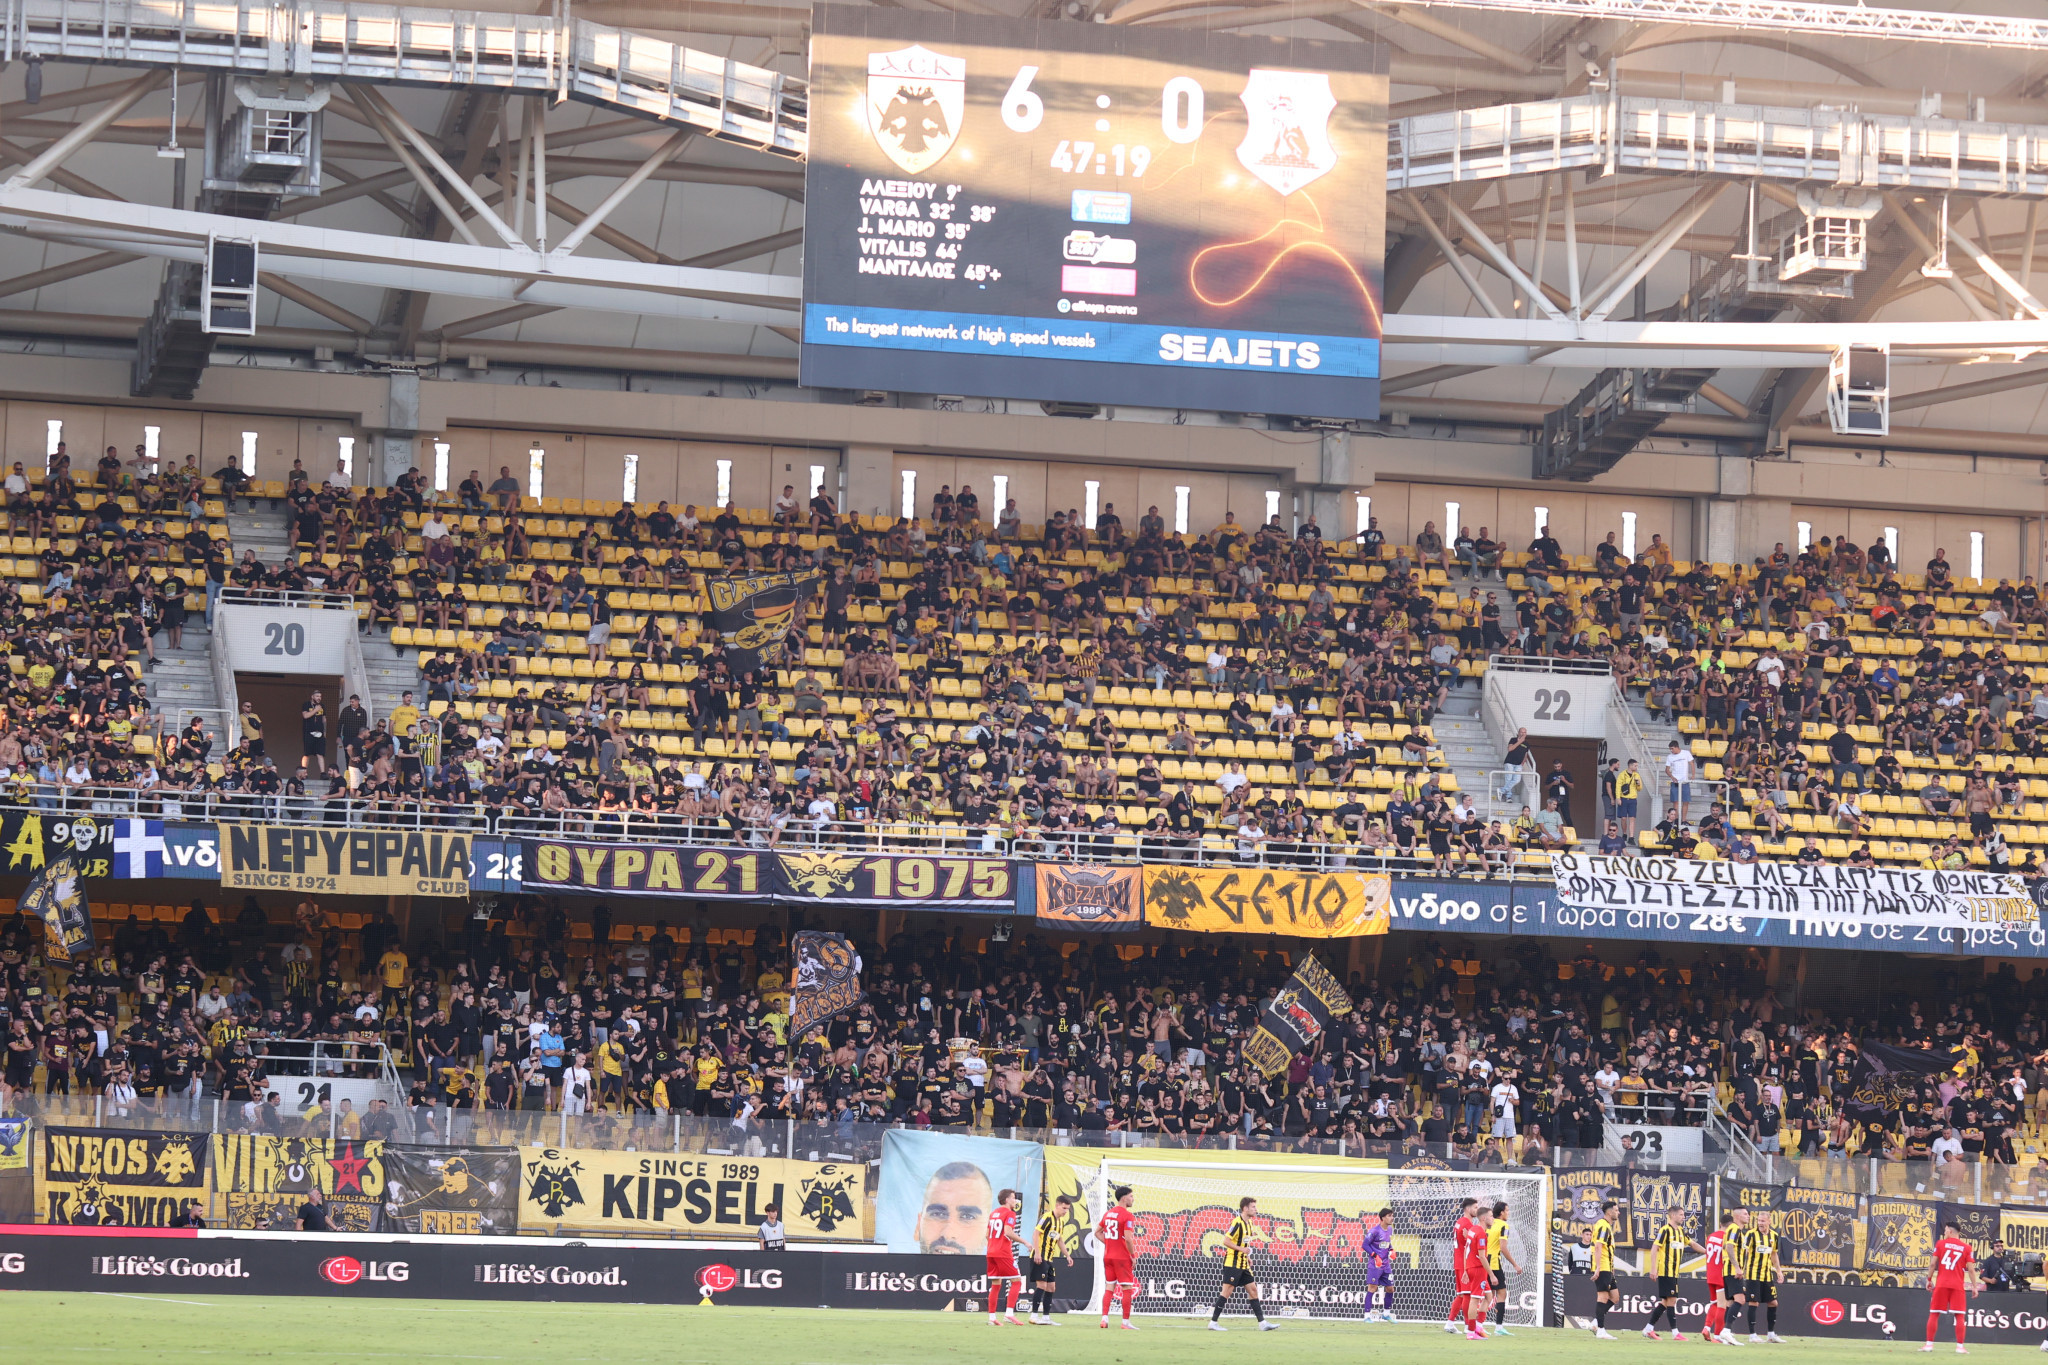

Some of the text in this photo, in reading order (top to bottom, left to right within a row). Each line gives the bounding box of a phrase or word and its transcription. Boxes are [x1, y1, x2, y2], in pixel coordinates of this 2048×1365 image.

[1001, 66, 1043, 133] 6
[1162, 76, 1204, 143] 0
[1050, 140, 1151, 178] 47:19
[860, 179, 937, 199] ΑΛΕΞΙΟΥ
[860, 198, 920, 218] VARGA
[929, 203, 956, 220] 32'
[857, 217, 971, 240] J. MARIO 35'
[859, 237, 962, 260] VITALIS 44'
[858, 257, 956, 280] ΜΑΝΤΑΛΟΣ
[825, 317, 1096, 348] The largest network of high speed vessels
[1158, 333, 1321, 369] SEAJETS
[264, 622, 305, 656] 20
[1533, 688, 1571, 721] 22
[536, 843, 758, 893] ΘΥΡΑ 21
[863, 856, 1009, 899] 1975
[1690, 861, 1738, 886] ΖΕΙ
[1754, 862, 1829, 889] ΜΕΣΑ
[233, 873, 336, 890] SINCE 1974
[417, 880, 467, 894] CLUB
[1046, 870, 1132, 914] KOZANI
[1076, 905, 1102, 915] 1988
[1489, 903, 1528, 923] σε
[1537, 900, 1547, 924] 1
[50, 1136, 149, 1175] NEOS
[1630, 1130, 1663, 1160] 23
[639, 1159, 759, 1180] SINCE 1989
[1558, 1170, 1622, 1190] ORIGINAL
[602, 1174, 784, 1226] KIPSELI
[1632, 1182, 1702, 1212] KAMA
[420, 1211, 482, 1235] FREE
[1871, 1202, 1937, 1224] ORIGINAL 21
[1104, 1218, 1119, 1240] 33
[2006, 1223, 2048, 1253] ORIGI
[1706, 1243, 1722, 1265] 97
[1791, 1249, 1841, 1268] LABRINI
[1868, 1249, 1932, 1269] LAMIA CLUB
[1940, 1249, 1963, 1271] 47
[100, 1256, 250, 1278] Life's Good.
[369, 1261, 409, 1282] LG
[483, 1264, 628, 1286] Life's Good.
[743, 1269, 783, 1289] LG
[854, 1272, 916, 1293] Life's
[1148, 1278, 1187, 1300] LG
[1257, 1282, 1316, 1303] Life's
[1850, 1303, 1888, 1323] LG
[2013, 1311, 2048, 1330] Go
